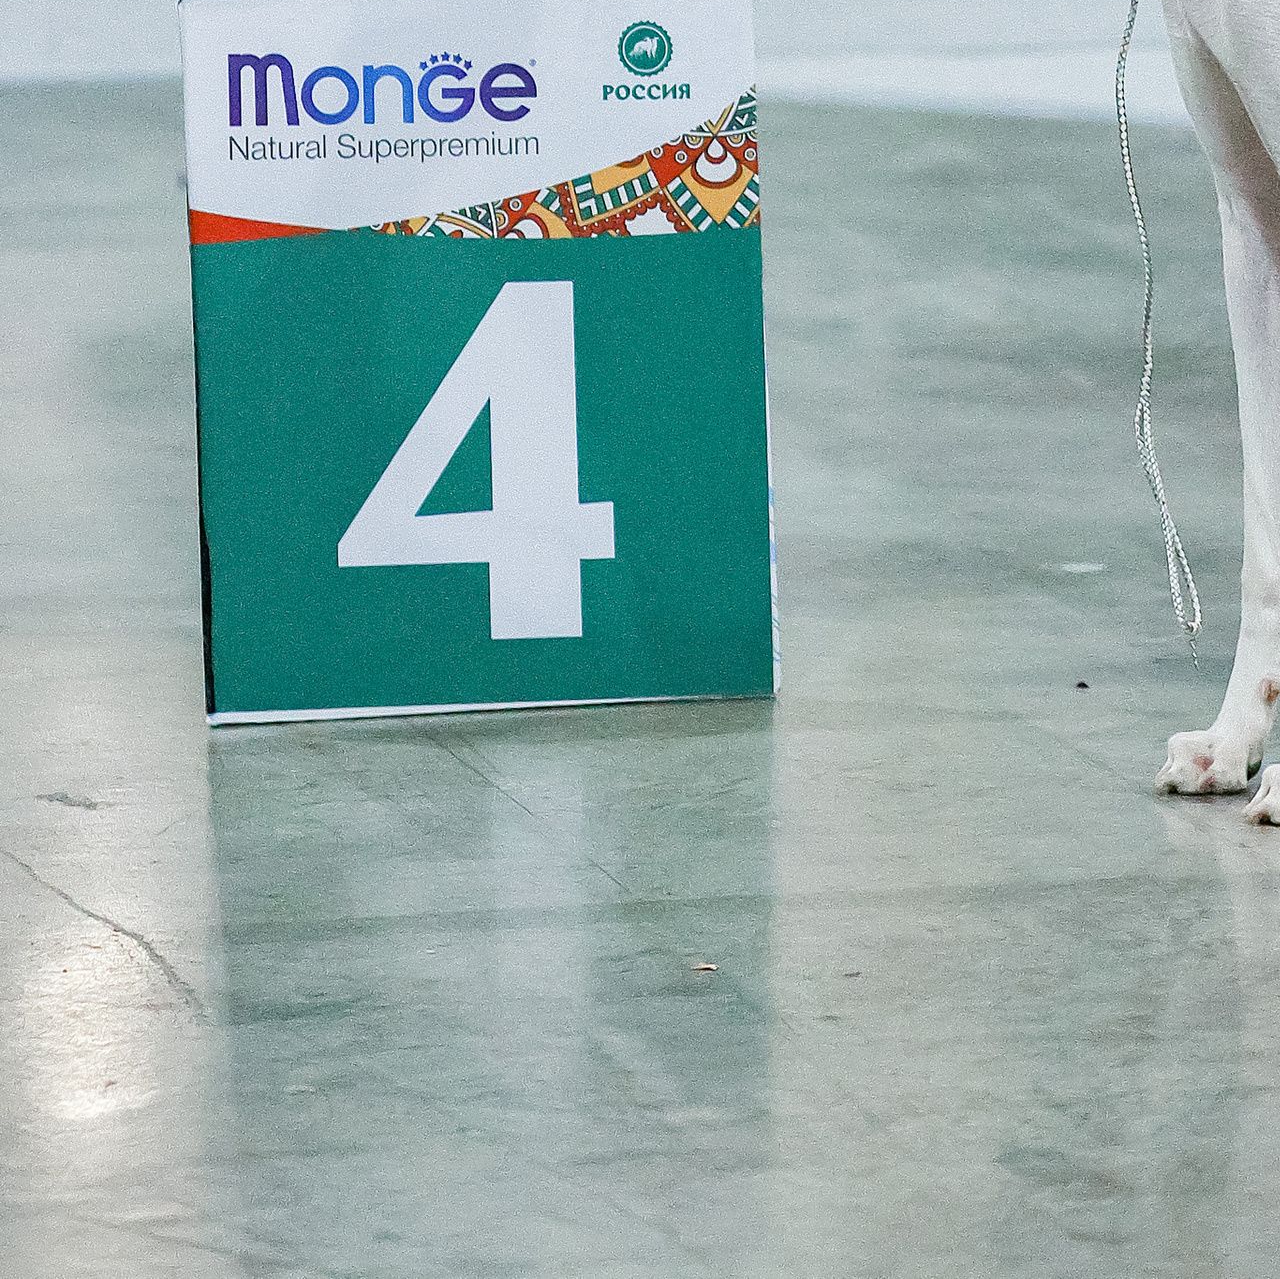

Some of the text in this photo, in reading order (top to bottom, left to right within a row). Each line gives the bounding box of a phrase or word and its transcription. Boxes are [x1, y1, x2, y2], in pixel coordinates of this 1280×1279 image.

[602, 83, 691, 101] РОССИЯ
[228, 131, 540, 163] Natural Superpremium
[336, 280, 616, 641] 4
